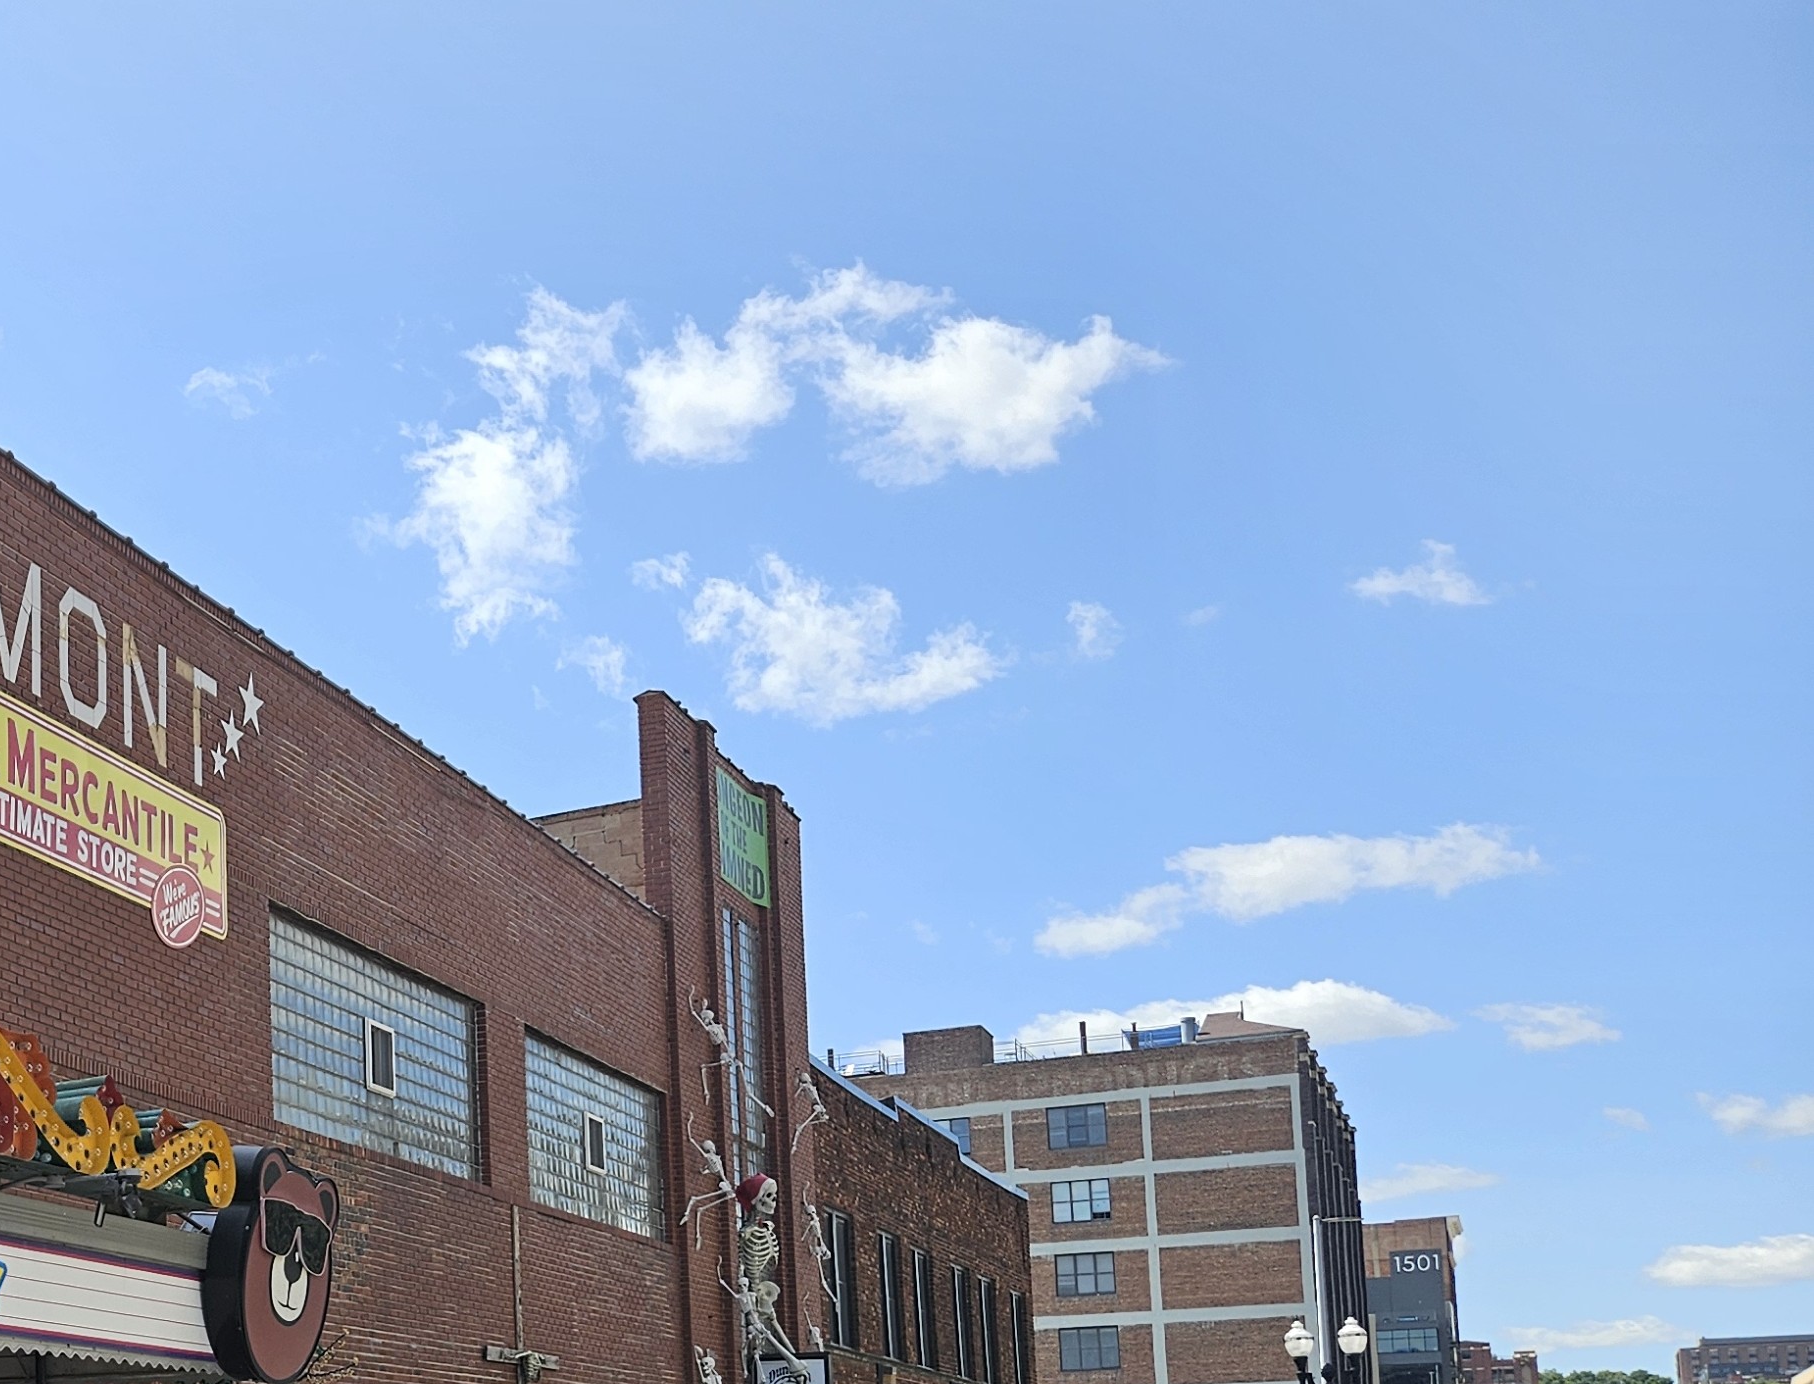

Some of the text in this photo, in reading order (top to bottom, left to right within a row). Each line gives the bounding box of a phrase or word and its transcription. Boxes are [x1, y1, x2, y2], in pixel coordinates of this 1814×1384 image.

[7, 726, 201, 876] MERCANTILE
[77, 832, 138, 888] STORE
[159, 891, 200, 936] FAMOUS
[1393, 1253, 1440, 1273] 1501
[768, 1365, 812, 1384] Dunn
